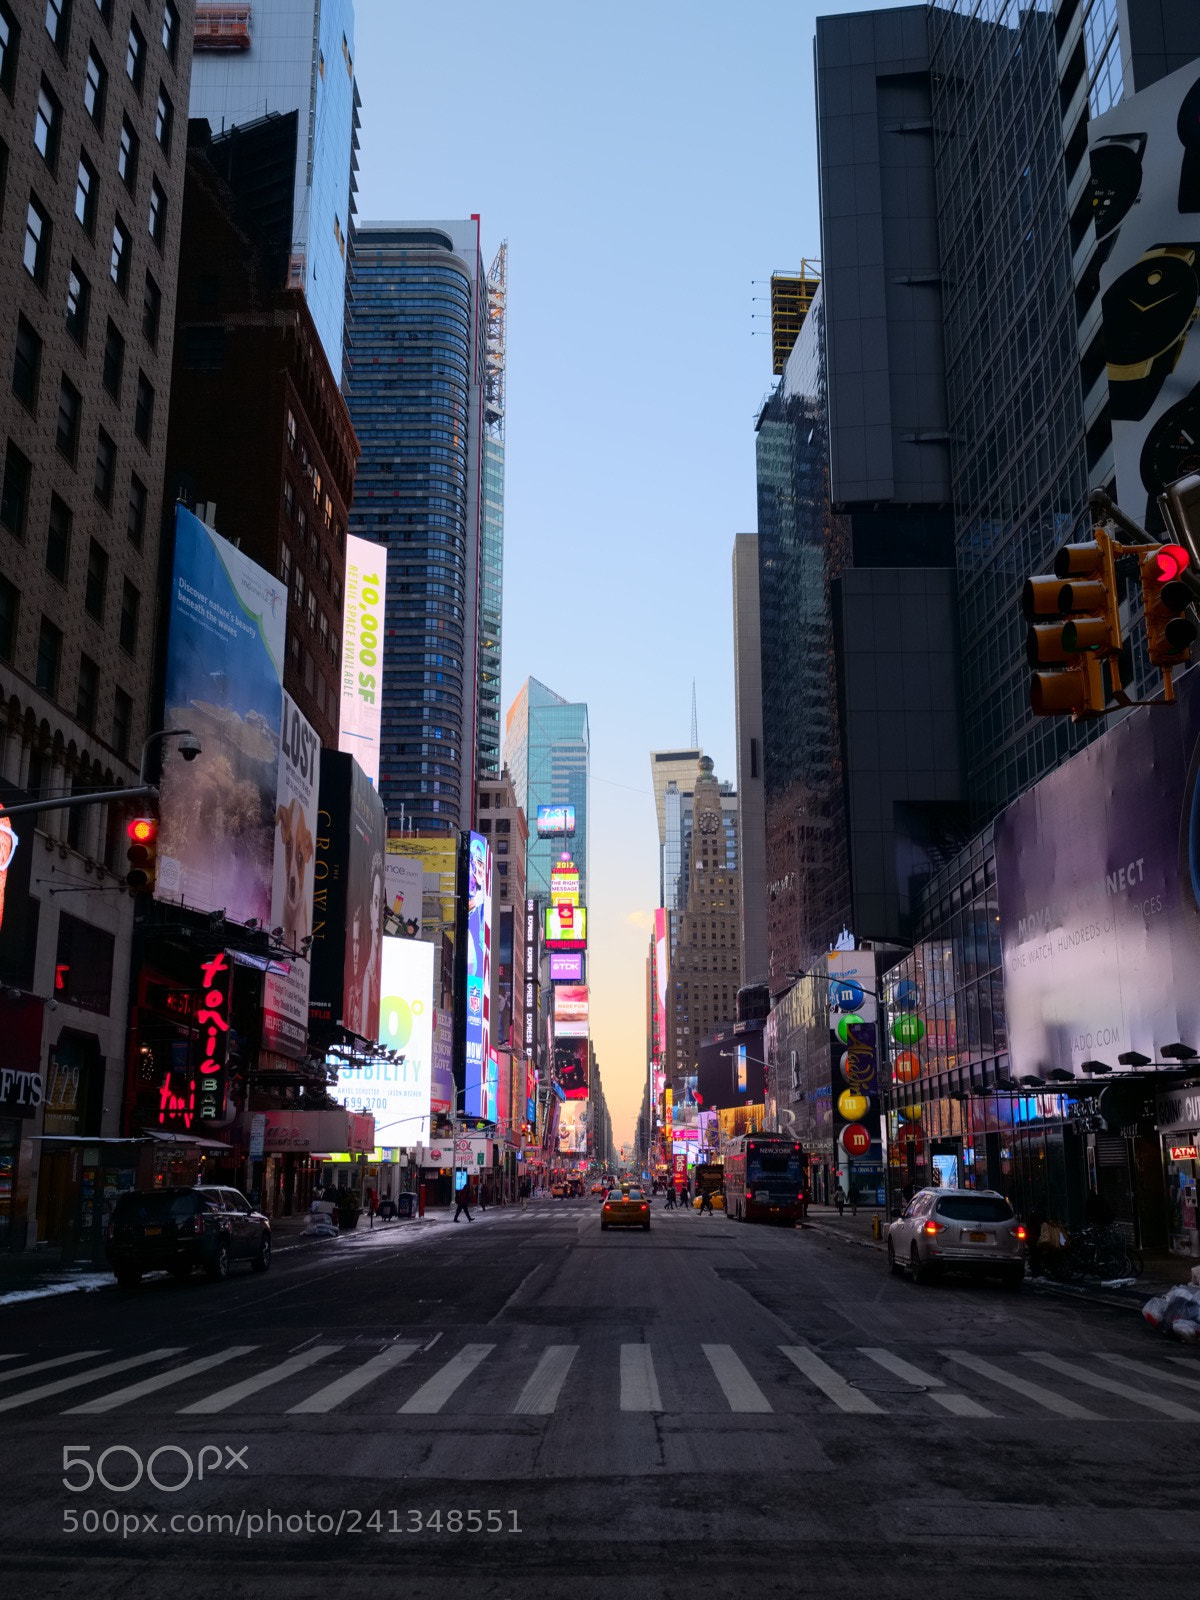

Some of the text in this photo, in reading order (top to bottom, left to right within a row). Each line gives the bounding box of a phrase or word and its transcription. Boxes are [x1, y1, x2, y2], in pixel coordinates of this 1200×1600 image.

[177, 589, 206, 617] beneath
[206, 610, 218, 624] the
[217, 619, 238, 638] waves
[178, 576, 208, 605] Discover
[208, 600, 235, 623] nature's
[234, 615, 257, 640] beauty
[343, 564, 359, 699] RETAIL SPACE AVAILABLE
[358, 573, 379, 705] 10,000 SF
[282, 695, 318, 788] LOST
[312, 808, 333, 942] CROWN
[545, 940, 587, 949] TOSHIBA
[1011, 953, 1027, 972] ONE
[1057, 921, 1101, 952] HUNDREDS
[559, 963, 579, 971] TDK
[841, 990, 854, 1001] m
[197, 952, 229, 1075] tonic
[436, 1013, 453, 1028] HELP
[440, 1028, 452, 1043] HER
[433, 1042, 452, 1058] KNOW
[466, 1041, 482, 1060] NOW
[0, 1067, 44, 1107] FTS
[200, 1078, 219, 1119] BAR
[1158, 1100, 1183, 1125] GOING
[853, 1134, 866, 1146] m
[1174, 1147, 1196, 1157] ATM
[676, 1155, 684, 1172] tkts
